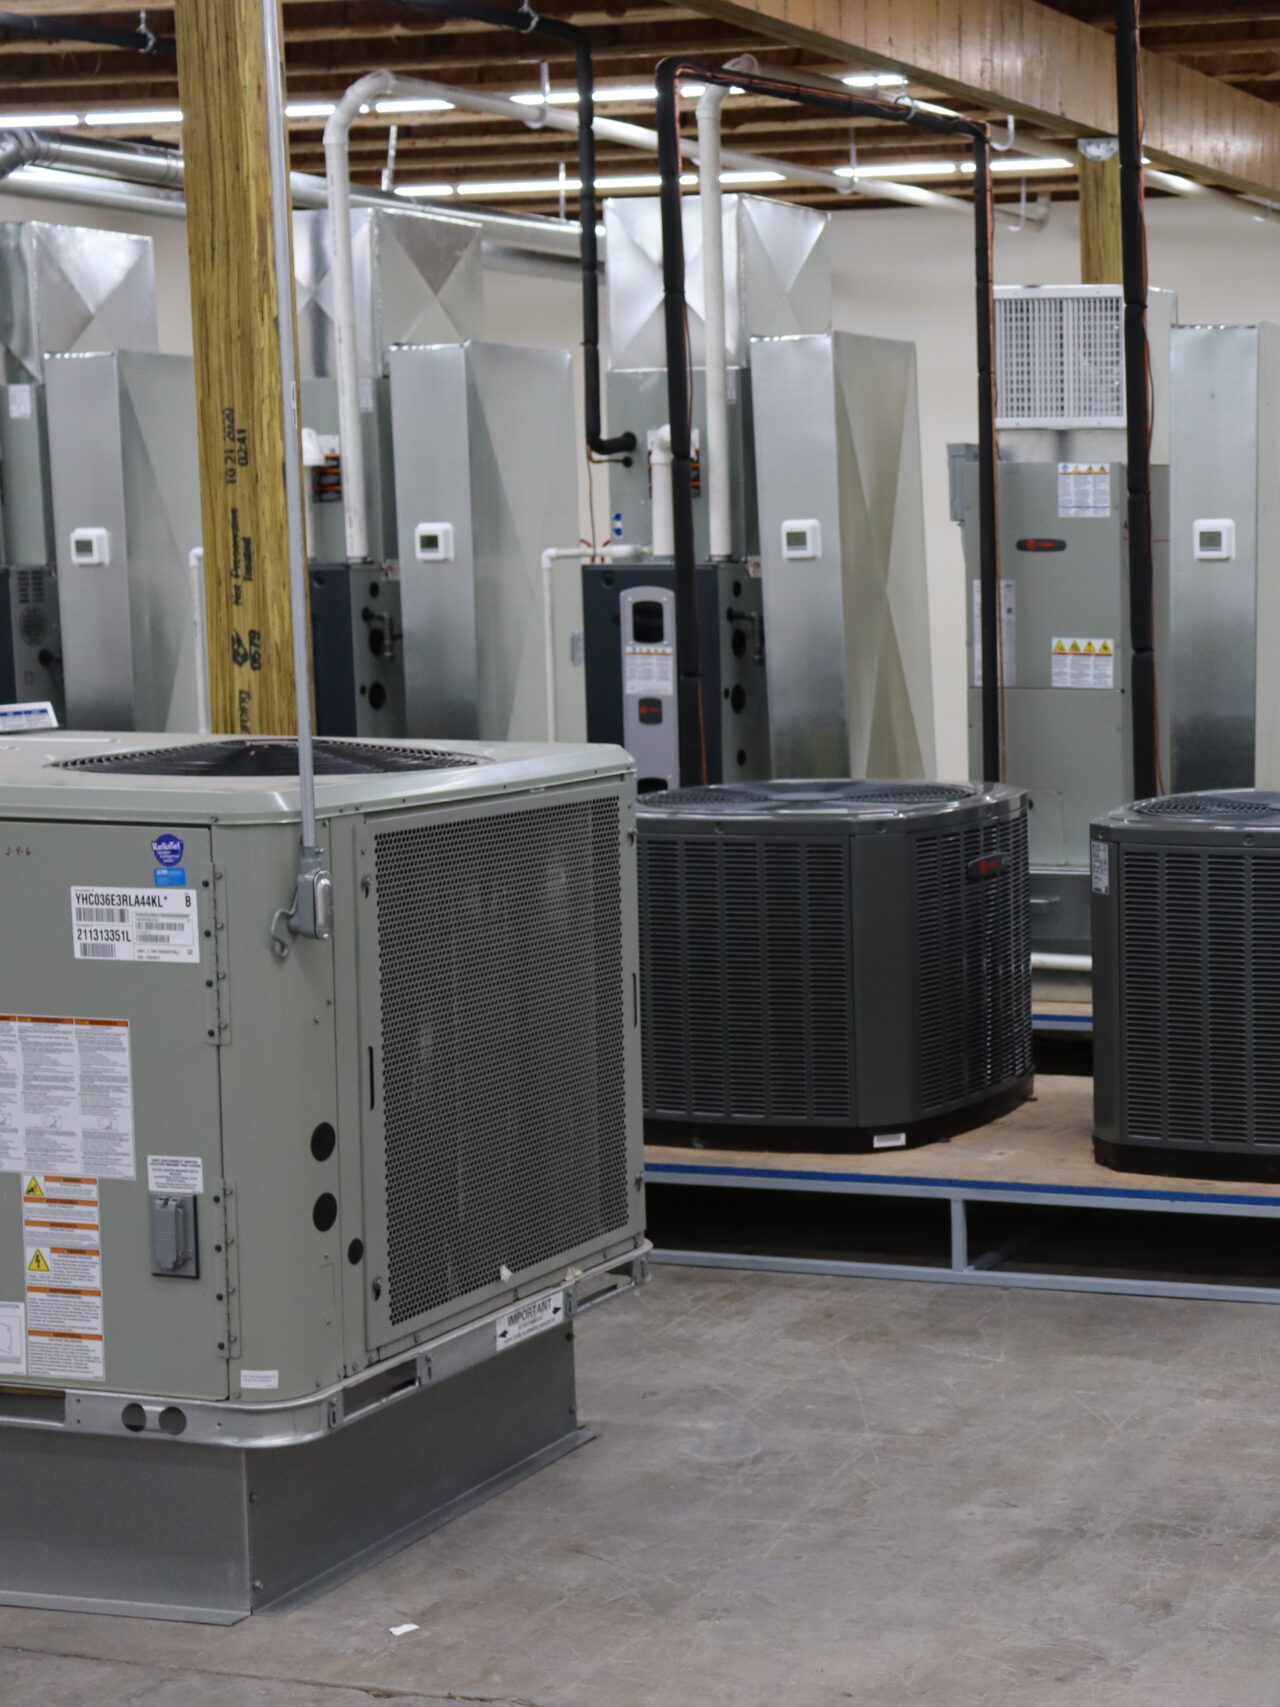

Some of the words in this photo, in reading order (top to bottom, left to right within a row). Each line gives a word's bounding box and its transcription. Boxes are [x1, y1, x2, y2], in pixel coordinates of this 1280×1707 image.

[185, 896, 191, 908] B
[77, 928, 131, 942] 211313351L
[507, 1298, 552, 1327] IMPORTANT
